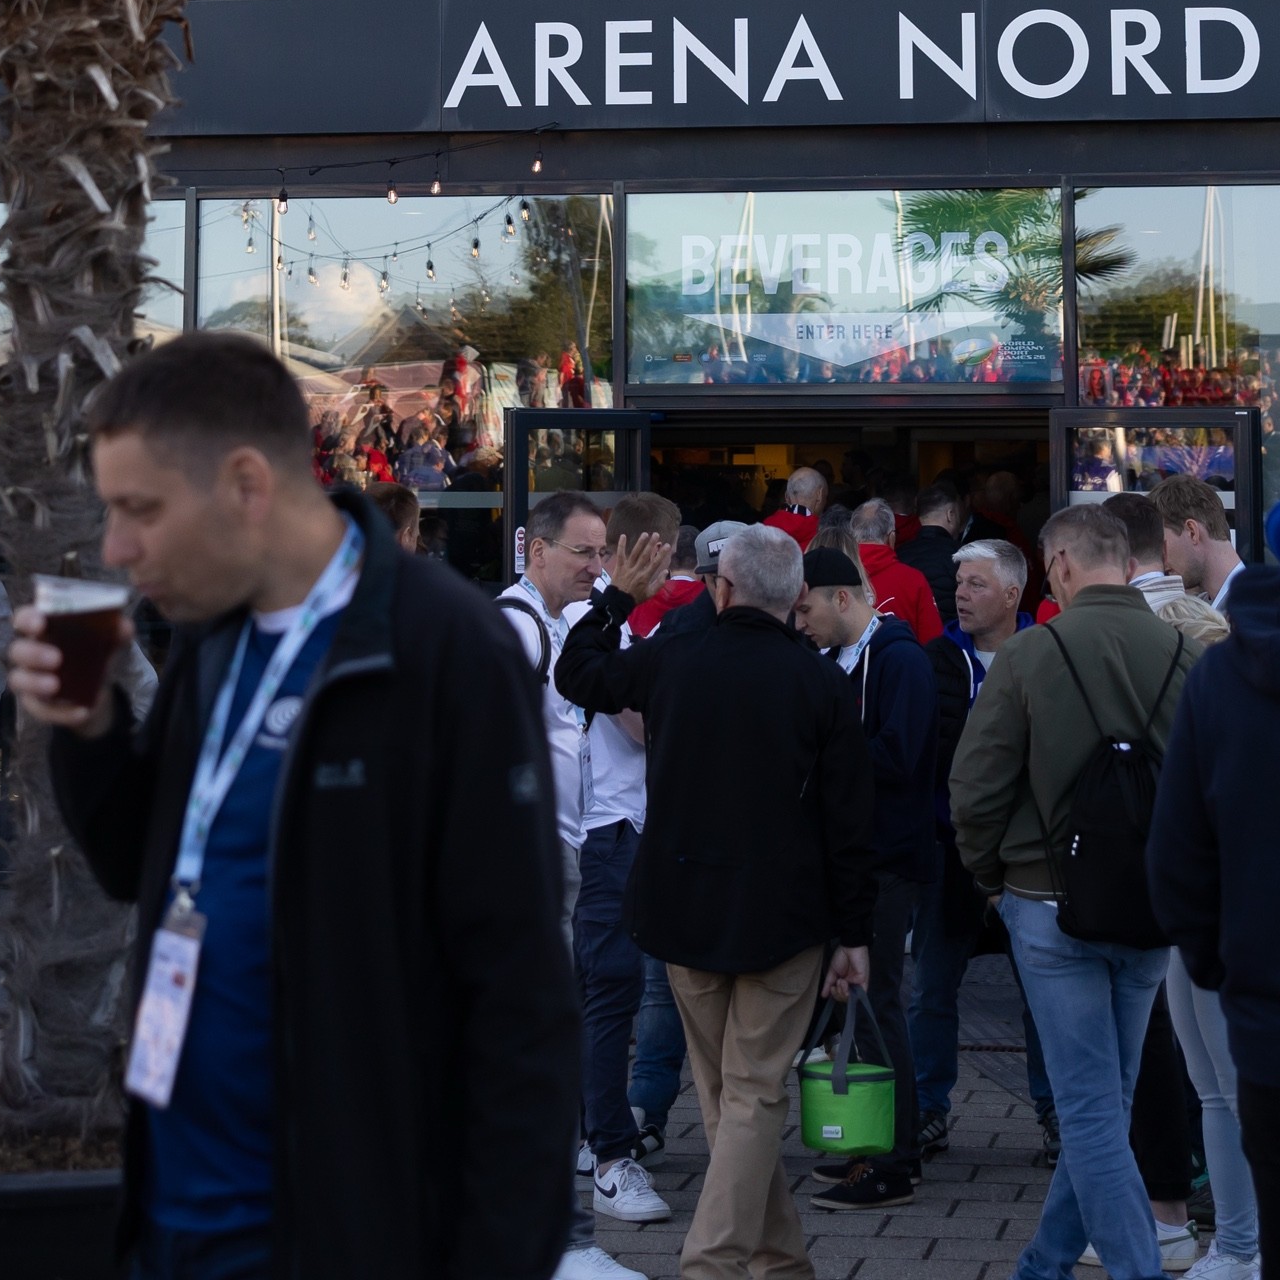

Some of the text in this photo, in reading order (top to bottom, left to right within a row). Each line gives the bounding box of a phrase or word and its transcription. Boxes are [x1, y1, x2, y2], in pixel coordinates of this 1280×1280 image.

[442, 6, 1262, 109] ARENA NORD
[680, 230, 1010, 297] BEVERAGES
[796, 324, 893, 340] ENTER HERE
